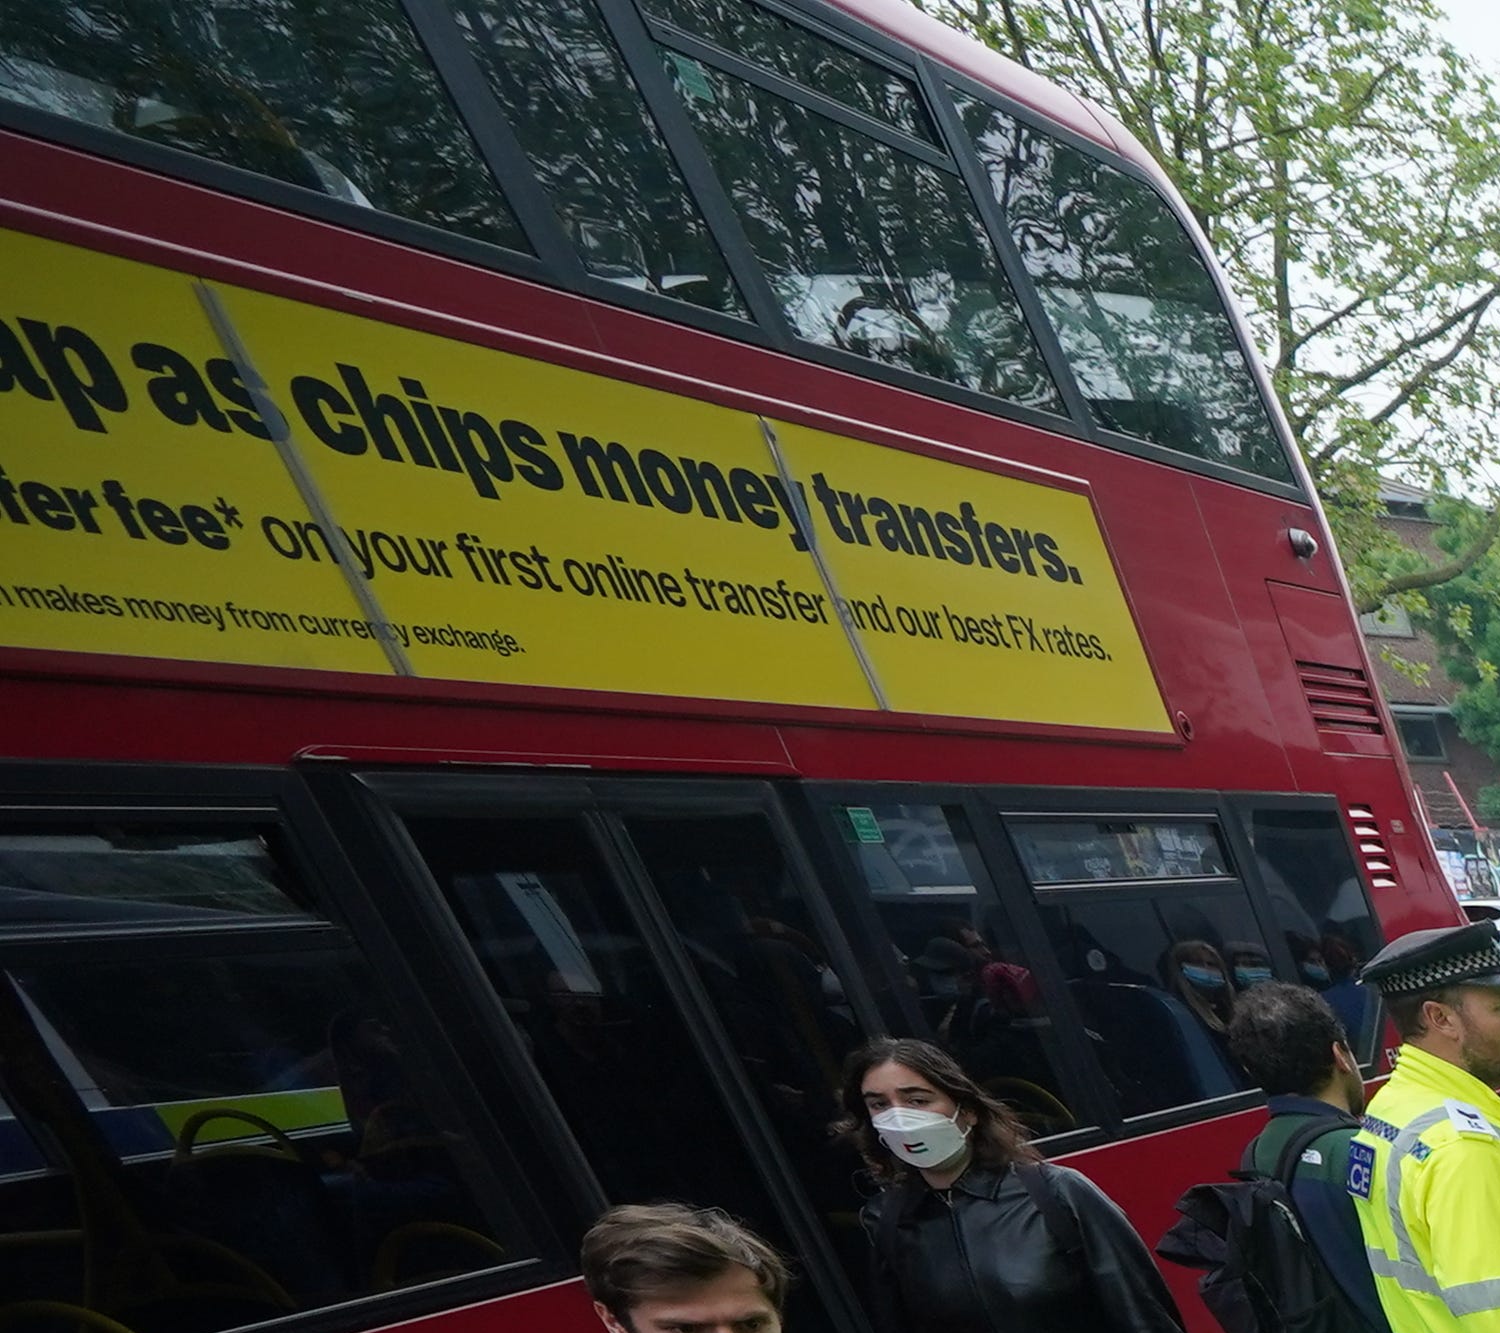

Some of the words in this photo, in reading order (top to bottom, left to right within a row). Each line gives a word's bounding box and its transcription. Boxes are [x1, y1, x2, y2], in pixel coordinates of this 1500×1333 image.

[131, 343, 290, 442] as
[290, 362, 564, 500] chips
[557, 431, 816, 551] money
[812, 472, 1083, 584] transfers.
[13, 584, 123, 617] makes
[124, 594, 225, 632] money
[226, 603, 303, 634] from
[298, 613, 410, 648] currency
[413, 622, 526, 657] exchange.
[261, 516, 340, 564] on
[339, 525, 453, 580] your
[456, 532, 562, 592] first
[563, 554, 686, 608] online
[685, 567, 829, 625] transfer
[896, 604, 943, 640] our
[945, 604, 1010, 649] best
[1008, 614, 1044, 654] FX
[1042, 625, 1112, 662] rates.
